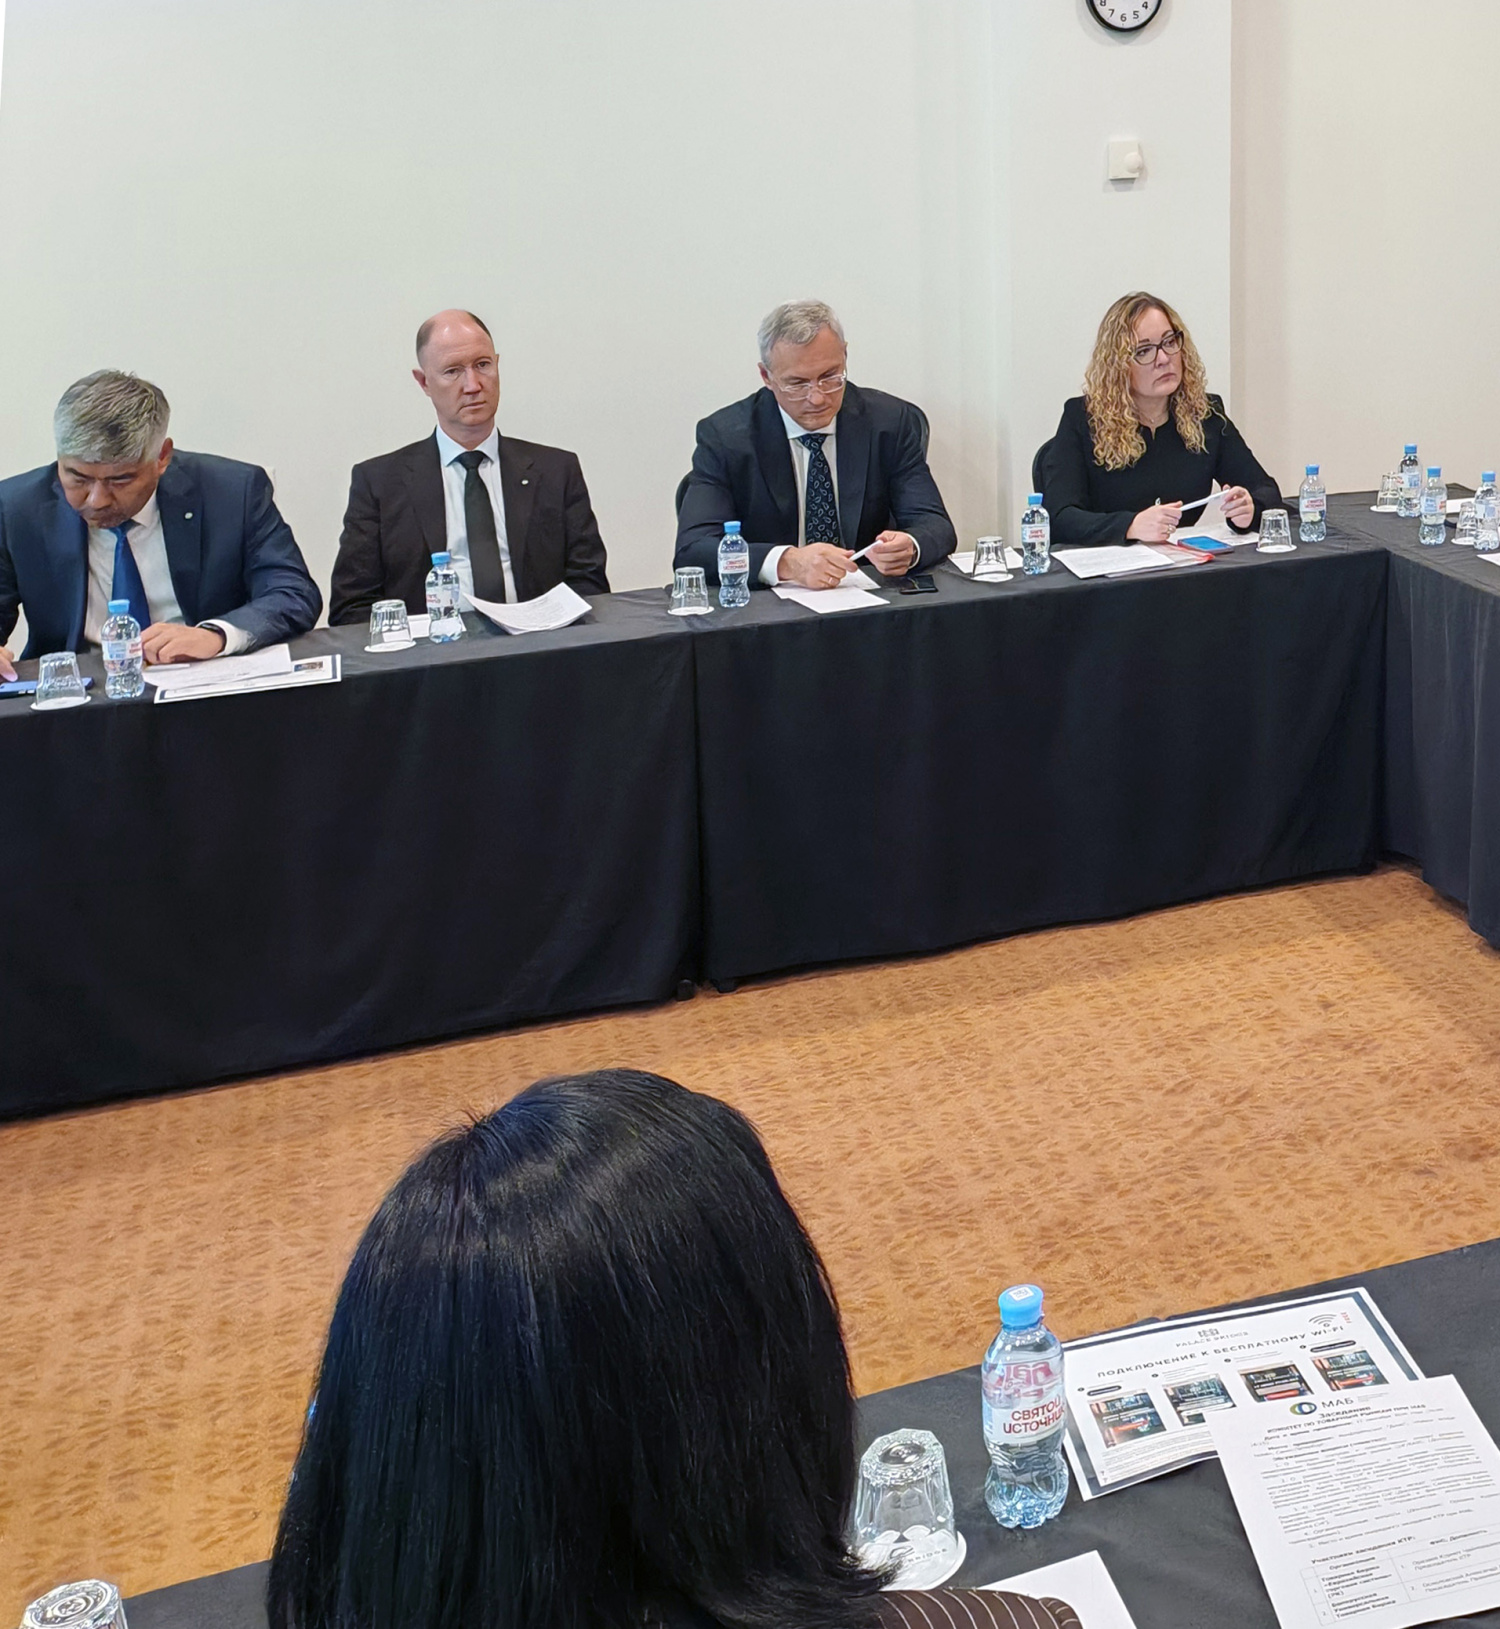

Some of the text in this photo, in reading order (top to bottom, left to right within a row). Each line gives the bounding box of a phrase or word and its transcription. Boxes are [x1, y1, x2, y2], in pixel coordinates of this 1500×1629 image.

[1142, 1, 1148, 9] 4
[1108, 9, 1115, 17] 7
[1132, 11, 1139, 19] 5
[1120, 13, 1127, 22] 6
[1097, 1353, 1197, 1378] ПОДКЛЮЧЕНИЕ
[1213, 1333, 1306, 1354] БЕСПЛАТНОМУ
[1311, 1326, 1344, 1337] WI-FI
[1321, 1397, 1354, 1408] МАБ
